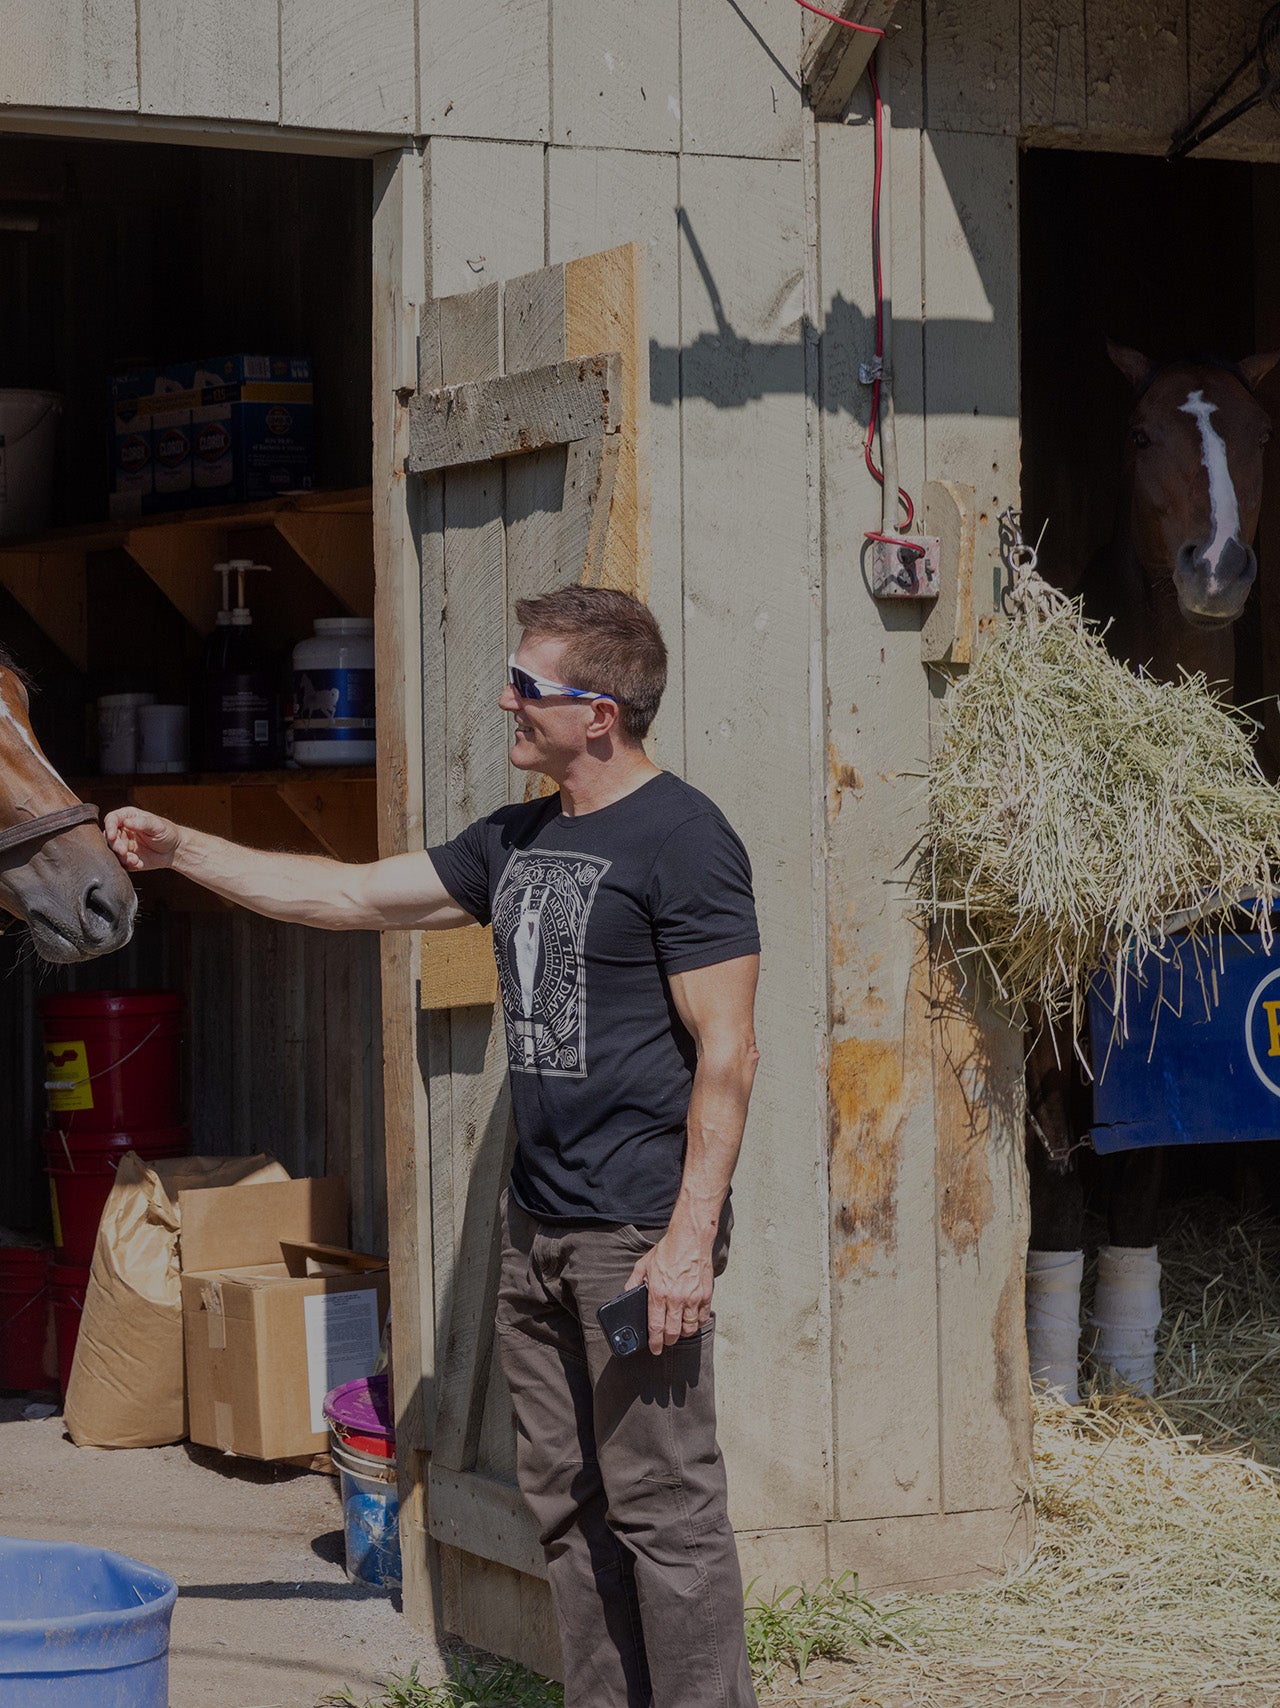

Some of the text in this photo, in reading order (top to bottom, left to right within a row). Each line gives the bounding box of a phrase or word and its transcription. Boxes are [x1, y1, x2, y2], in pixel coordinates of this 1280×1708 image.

[543, 896, 576, 1021] ARTIST TILL DEATH
